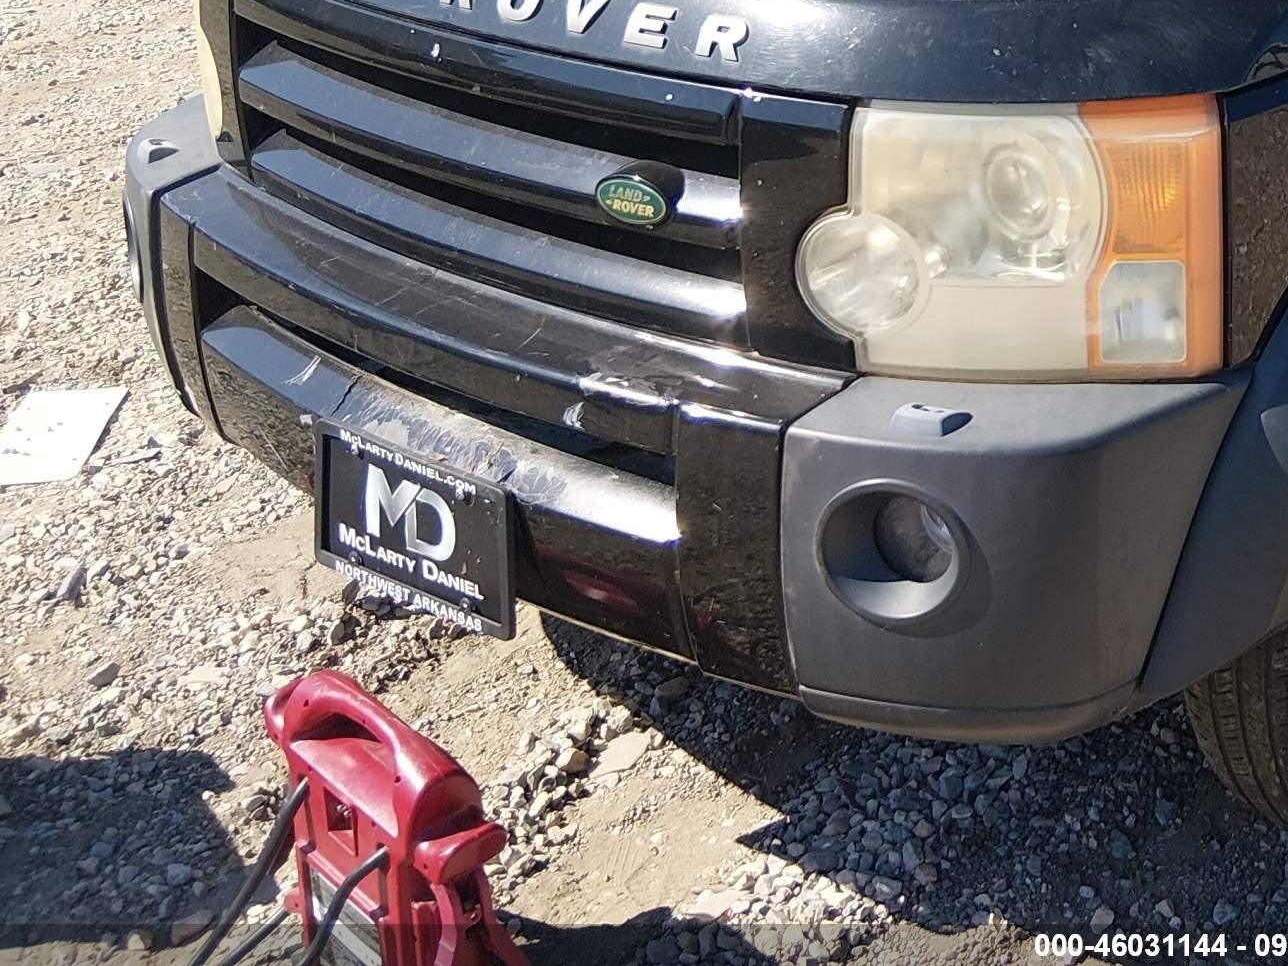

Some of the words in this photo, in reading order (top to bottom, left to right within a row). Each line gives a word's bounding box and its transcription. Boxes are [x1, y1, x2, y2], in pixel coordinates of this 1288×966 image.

[608, 184, 642, 202] LAND
[612, 198, 655, 218] ROVER
[334, 560, 411, 603] NORTHWEST
[413, 593, 483, 632] ARKANSAS
